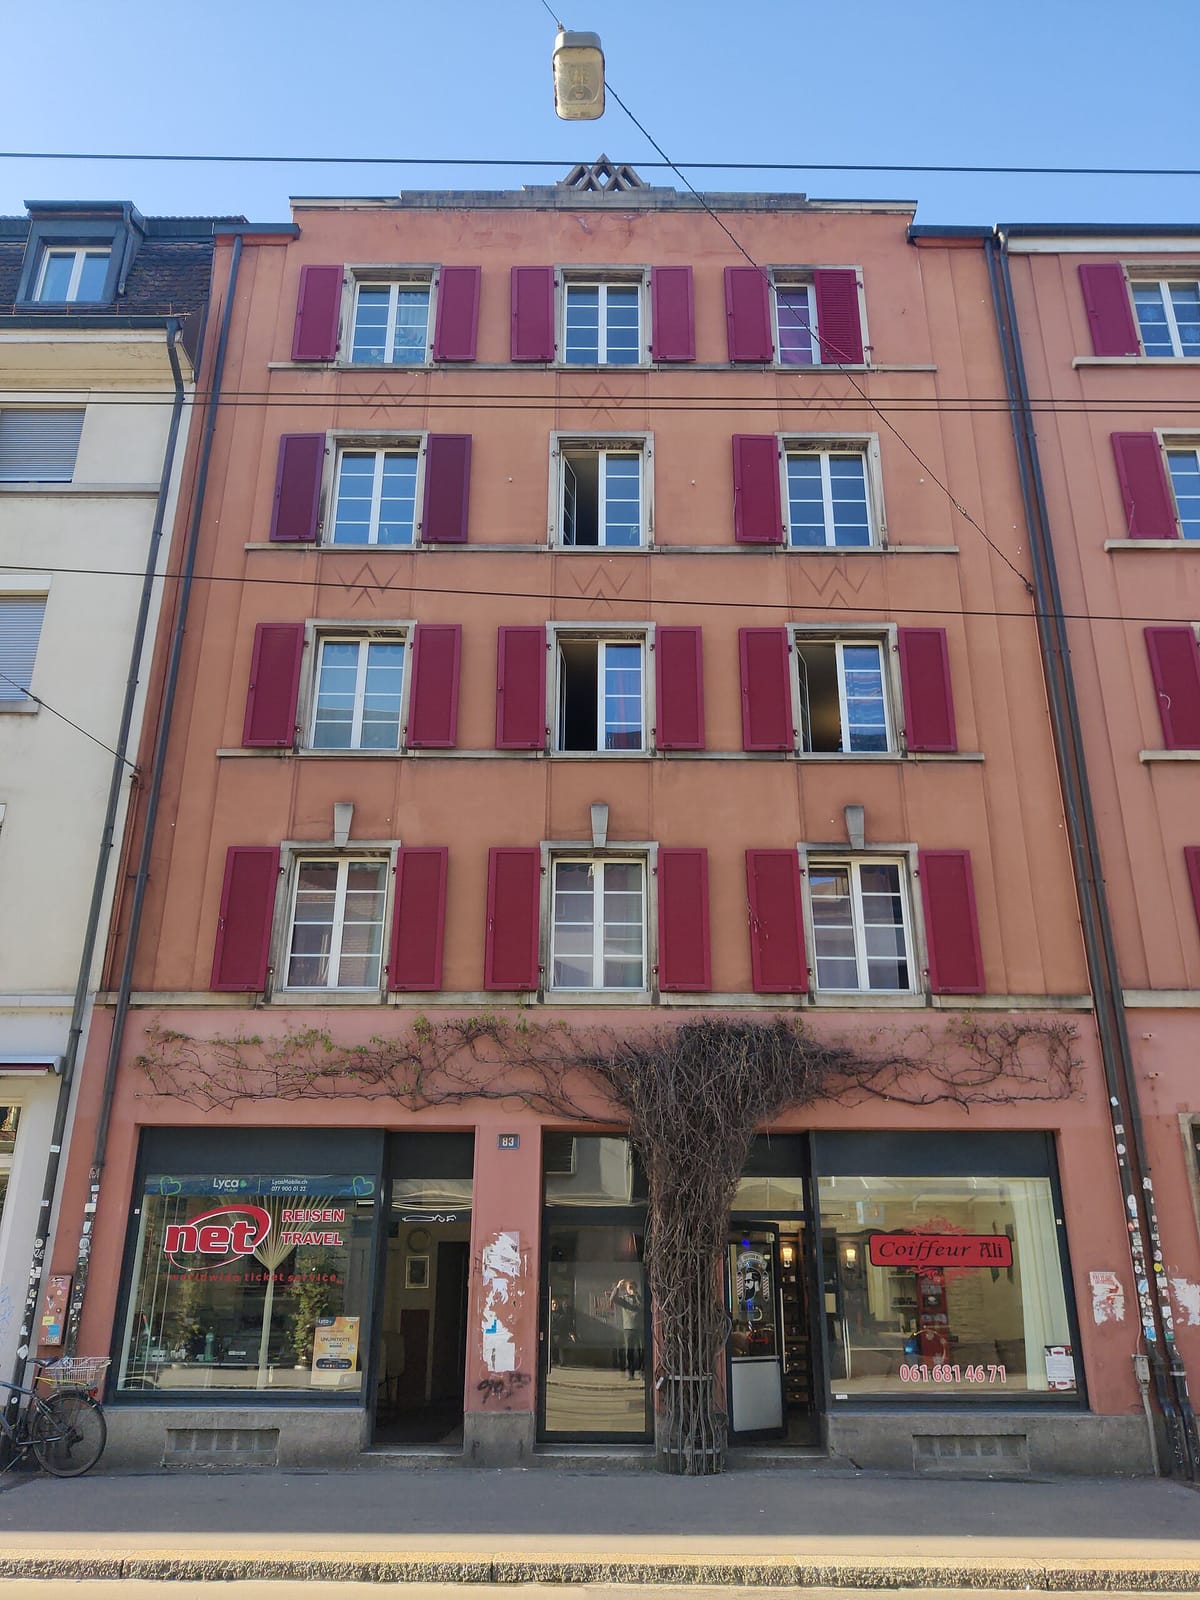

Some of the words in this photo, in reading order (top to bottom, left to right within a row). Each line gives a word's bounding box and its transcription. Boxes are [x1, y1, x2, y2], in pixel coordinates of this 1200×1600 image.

[502, 1137, 514, 1147] 83
[213, 1177, 240, 1190] Lyca
[282, 1208, 345, 1222] REISEN
[164, 1220, 257, 1255] net
[281, 1232, 343, 1246] TRAVEL
[880, 1240, 971, 1261] Coiffeur
[979, 1242, 1004, 1258] Ali
[244, 1271, 286, 1282] ticket
[900, 1364, 928, 1383] 061
[932, 1364, 961, 1383] 681
[965, 1365, 986, 1383] 46
[987, 1365, 1007, 1383] 71
